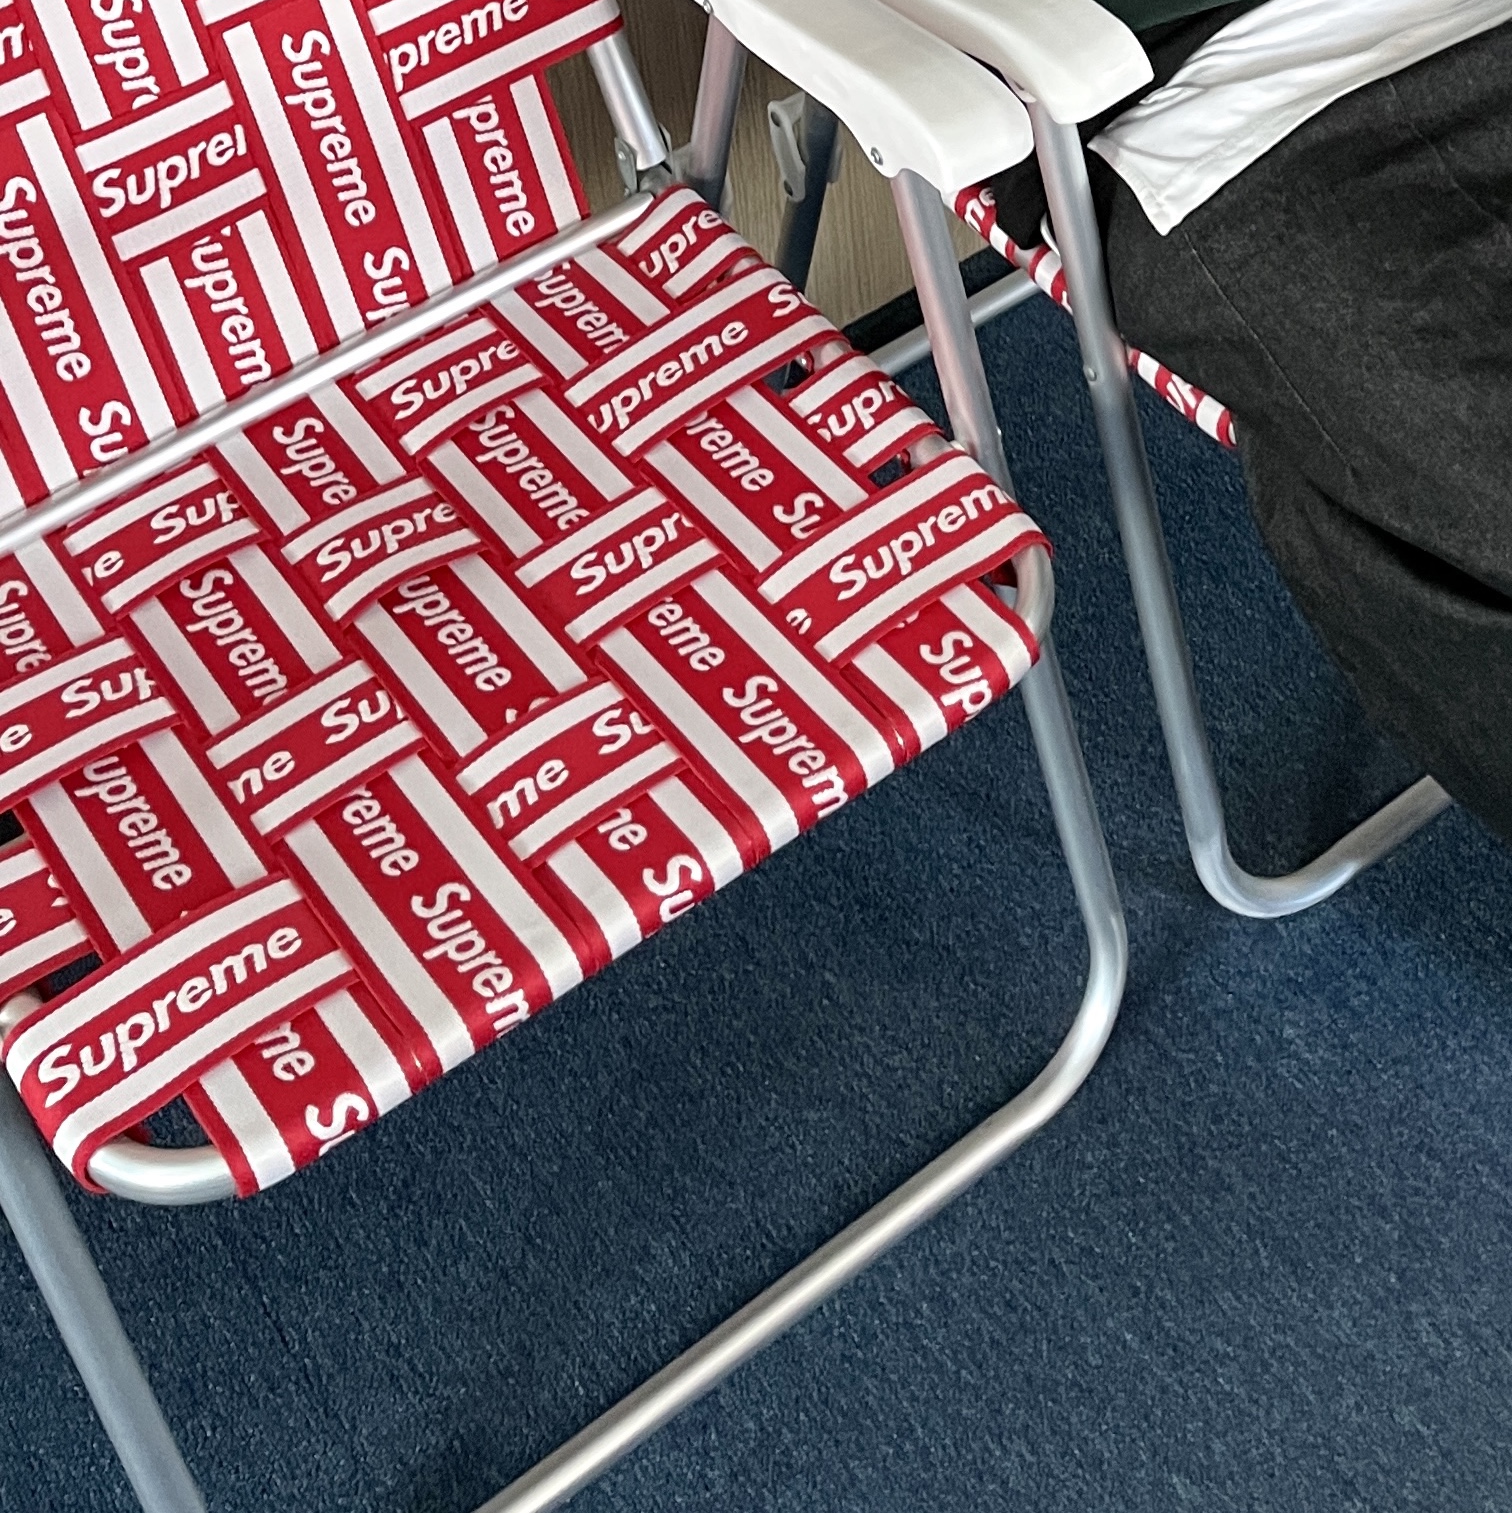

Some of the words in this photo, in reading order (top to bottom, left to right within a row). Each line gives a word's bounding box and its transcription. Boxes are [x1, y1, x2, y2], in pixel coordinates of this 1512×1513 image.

[281, 29, 376, 227] Supreme
[0, 176, 92, 382] Supreme
[183, 235, 272, 385] uprem
[767, 281, 815, 319] S
[81, 550, 125, 586] e
[37, 926, 303, 1109] Supreme
[304, 1091, 370, 1158] S
